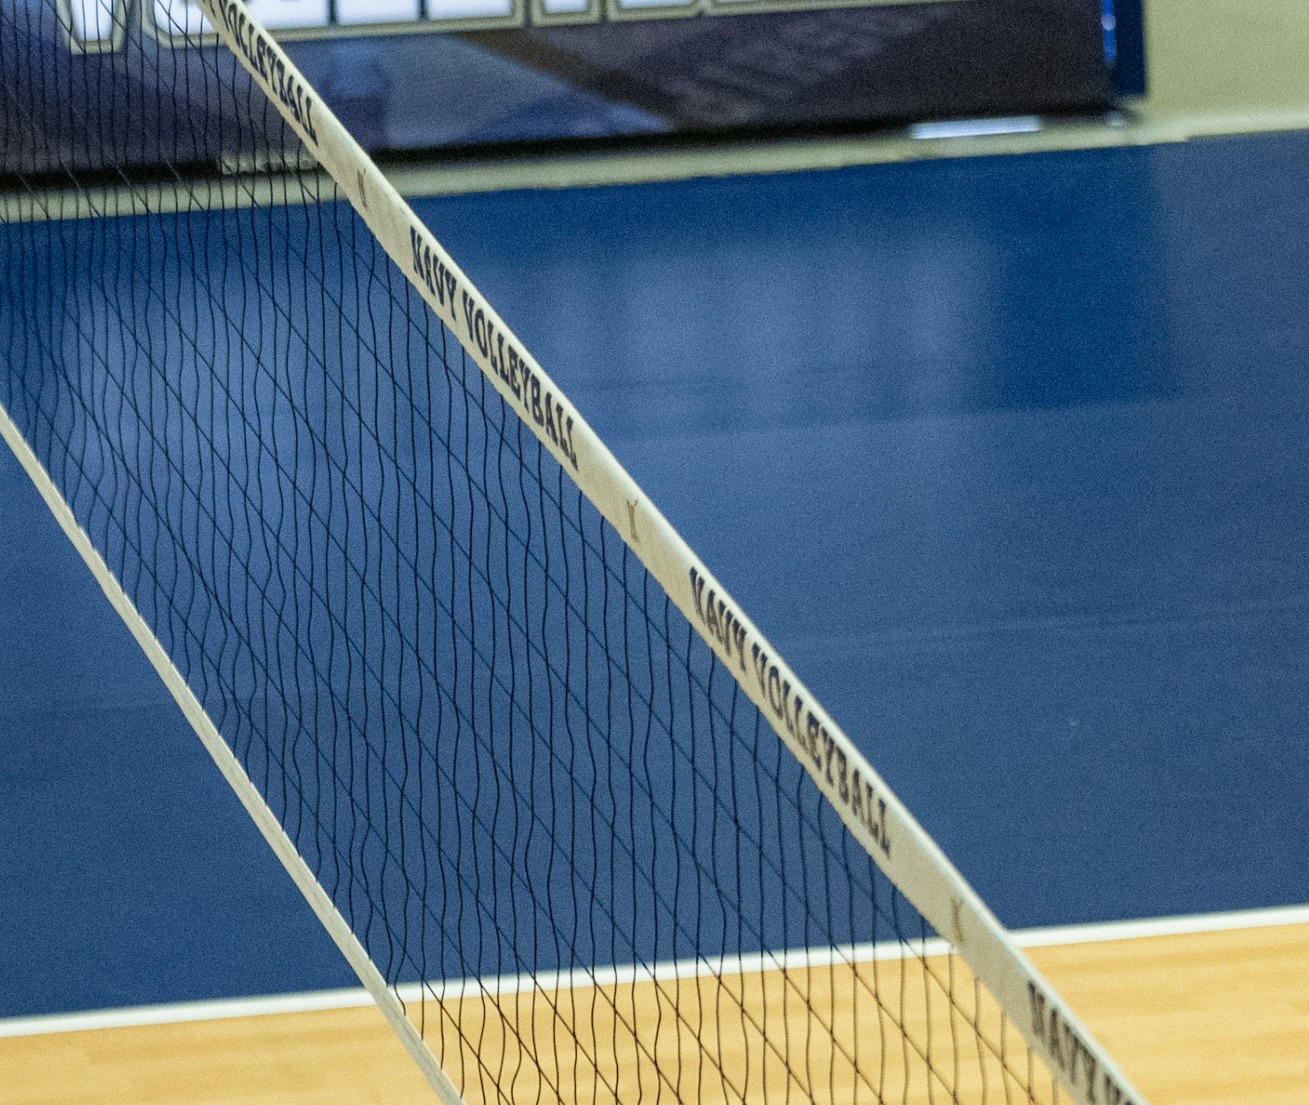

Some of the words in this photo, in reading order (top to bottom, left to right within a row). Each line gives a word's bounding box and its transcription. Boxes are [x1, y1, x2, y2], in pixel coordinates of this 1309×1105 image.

[410, 226, 457, 321] NAVY
[462, 289, 578, 473] VOLLEYBALL
[690, 567, 747, 672] NAVY
[752, 643, 890, 858] VOLLEYBALL
[1028, 980, 1095, 1105] NAVY
